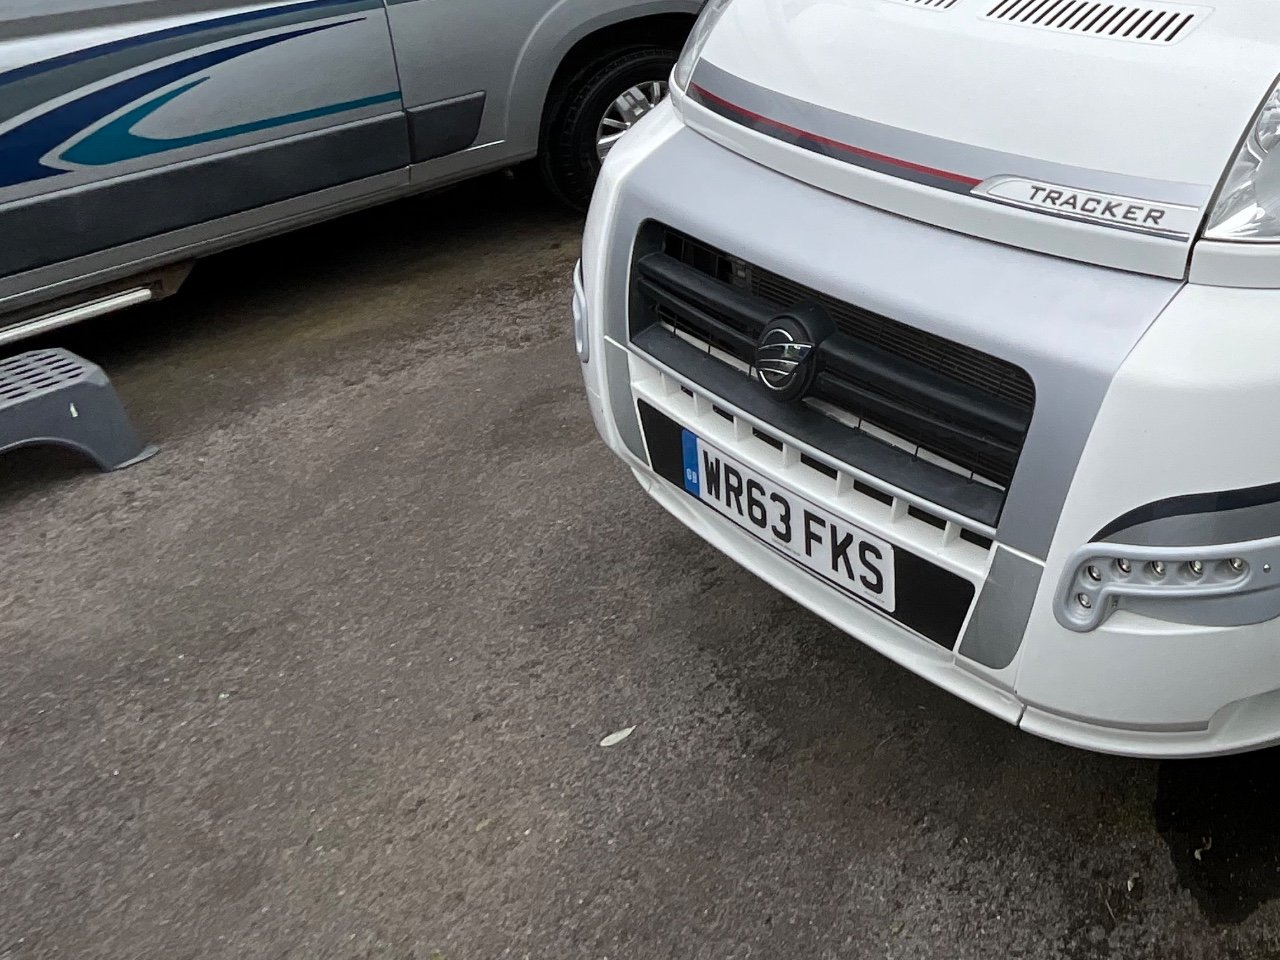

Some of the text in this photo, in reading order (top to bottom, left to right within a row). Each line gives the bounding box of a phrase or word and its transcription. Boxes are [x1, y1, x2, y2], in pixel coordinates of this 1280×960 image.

[1029, 185, 1166, 225] TRACKER
[702, 449, 885, 595] WR63 FKS
